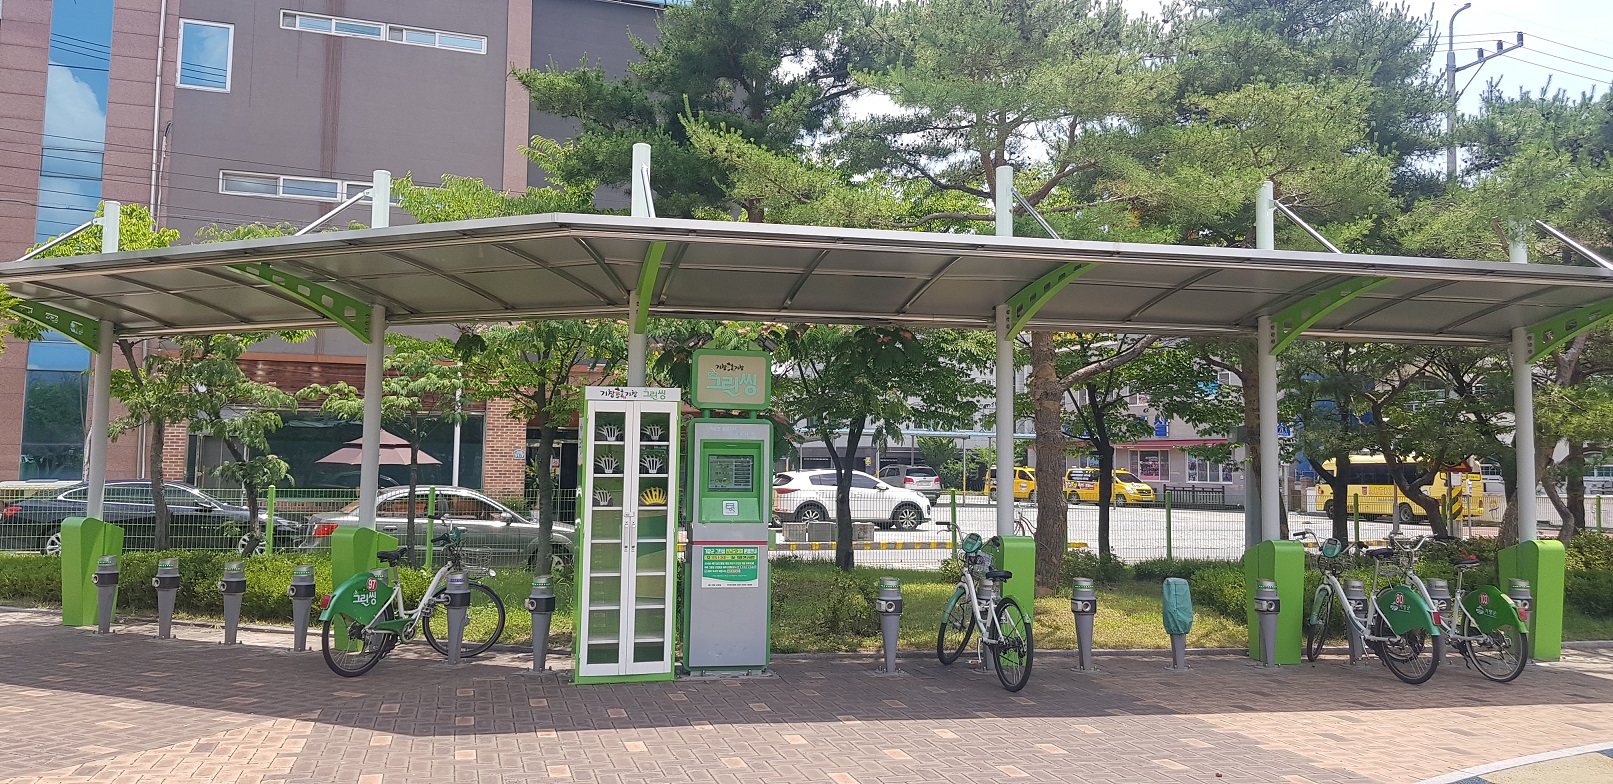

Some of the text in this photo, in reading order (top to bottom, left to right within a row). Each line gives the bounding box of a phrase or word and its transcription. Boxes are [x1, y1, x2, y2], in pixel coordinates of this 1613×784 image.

[706, 369, 758, 398] 그린씽
[642, 388, 667, 400] 그린씽
[368, 579, 376, 589] 97
[352, 590, 376, 606] 그린씽
[1396, 593, 1404, 603] 80
[1480, 594, 1488, 604] 103
